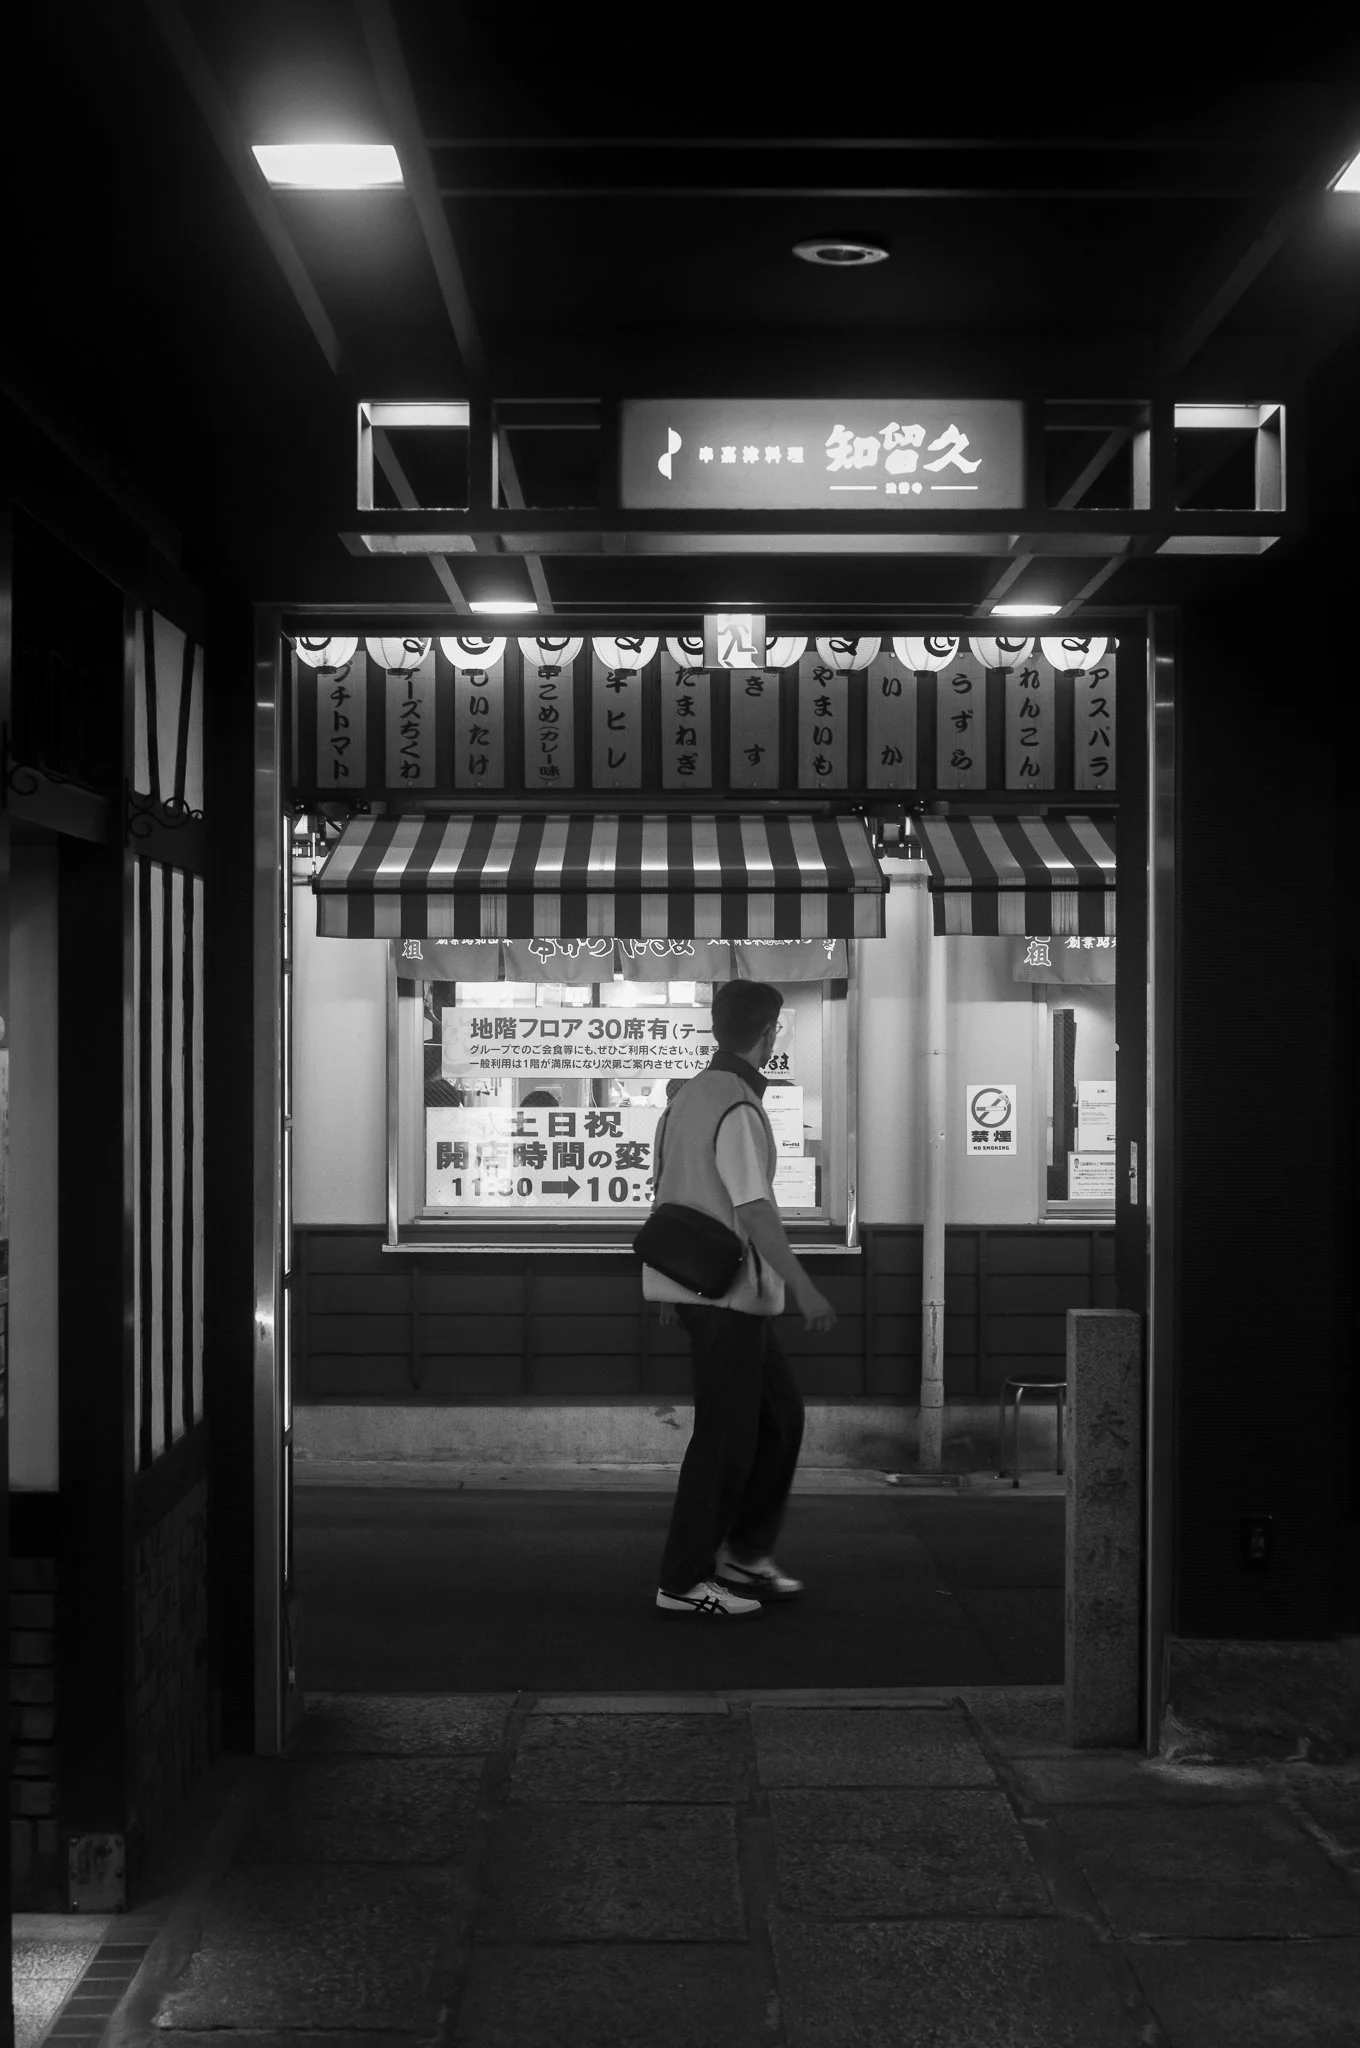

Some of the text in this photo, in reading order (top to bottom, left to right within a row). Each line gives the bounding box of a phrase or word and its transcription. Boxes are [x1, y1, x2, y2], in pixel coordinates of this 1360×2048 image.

[825, 422, 982, 474] 知留久
[675, 666, 699, 776] たまねぎ
[813, 666, 834, 776] やまいも
[951, 673, 973, 770] うずら
[1019, 667, 1040, 777] れんこん
[1089, 668, 1110, 777] アスパラ
[509, 1111, 624, 1138] 土日祝
[971, 1130, 1012, 1142] 禁煙
